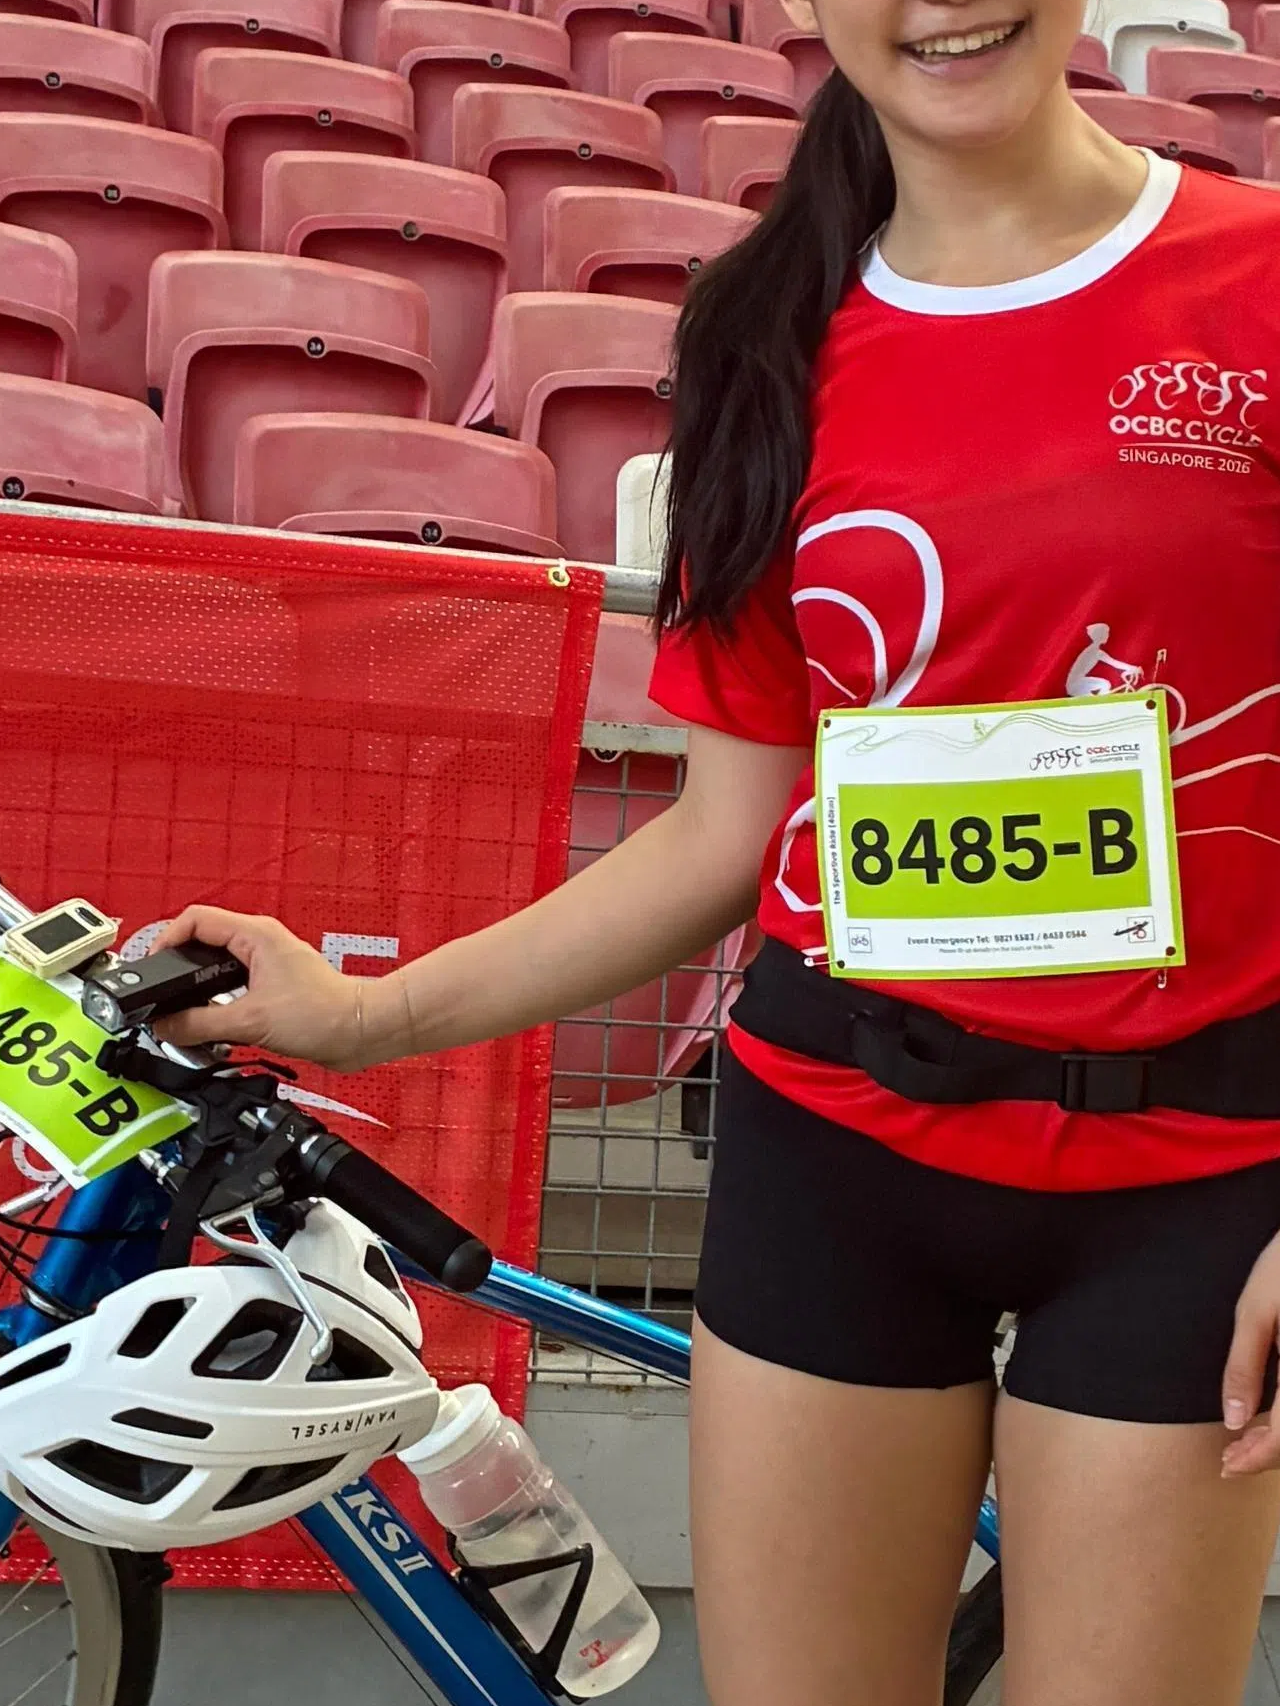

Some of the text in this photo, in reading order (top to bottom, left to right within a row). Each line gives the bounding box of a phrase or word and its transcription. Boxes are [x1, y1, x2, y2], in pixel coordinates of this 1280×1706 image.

[310, 341, 322, 351] 34
[1109, 414, 1264, 448] OCBC CYCLE
[1118, 448, 1214, 470] SINGAPORE
[6, 483, 21, 495] 35
[424, 528, 438, 539] 34
[850, 807, 1139, 887] 8485-B
